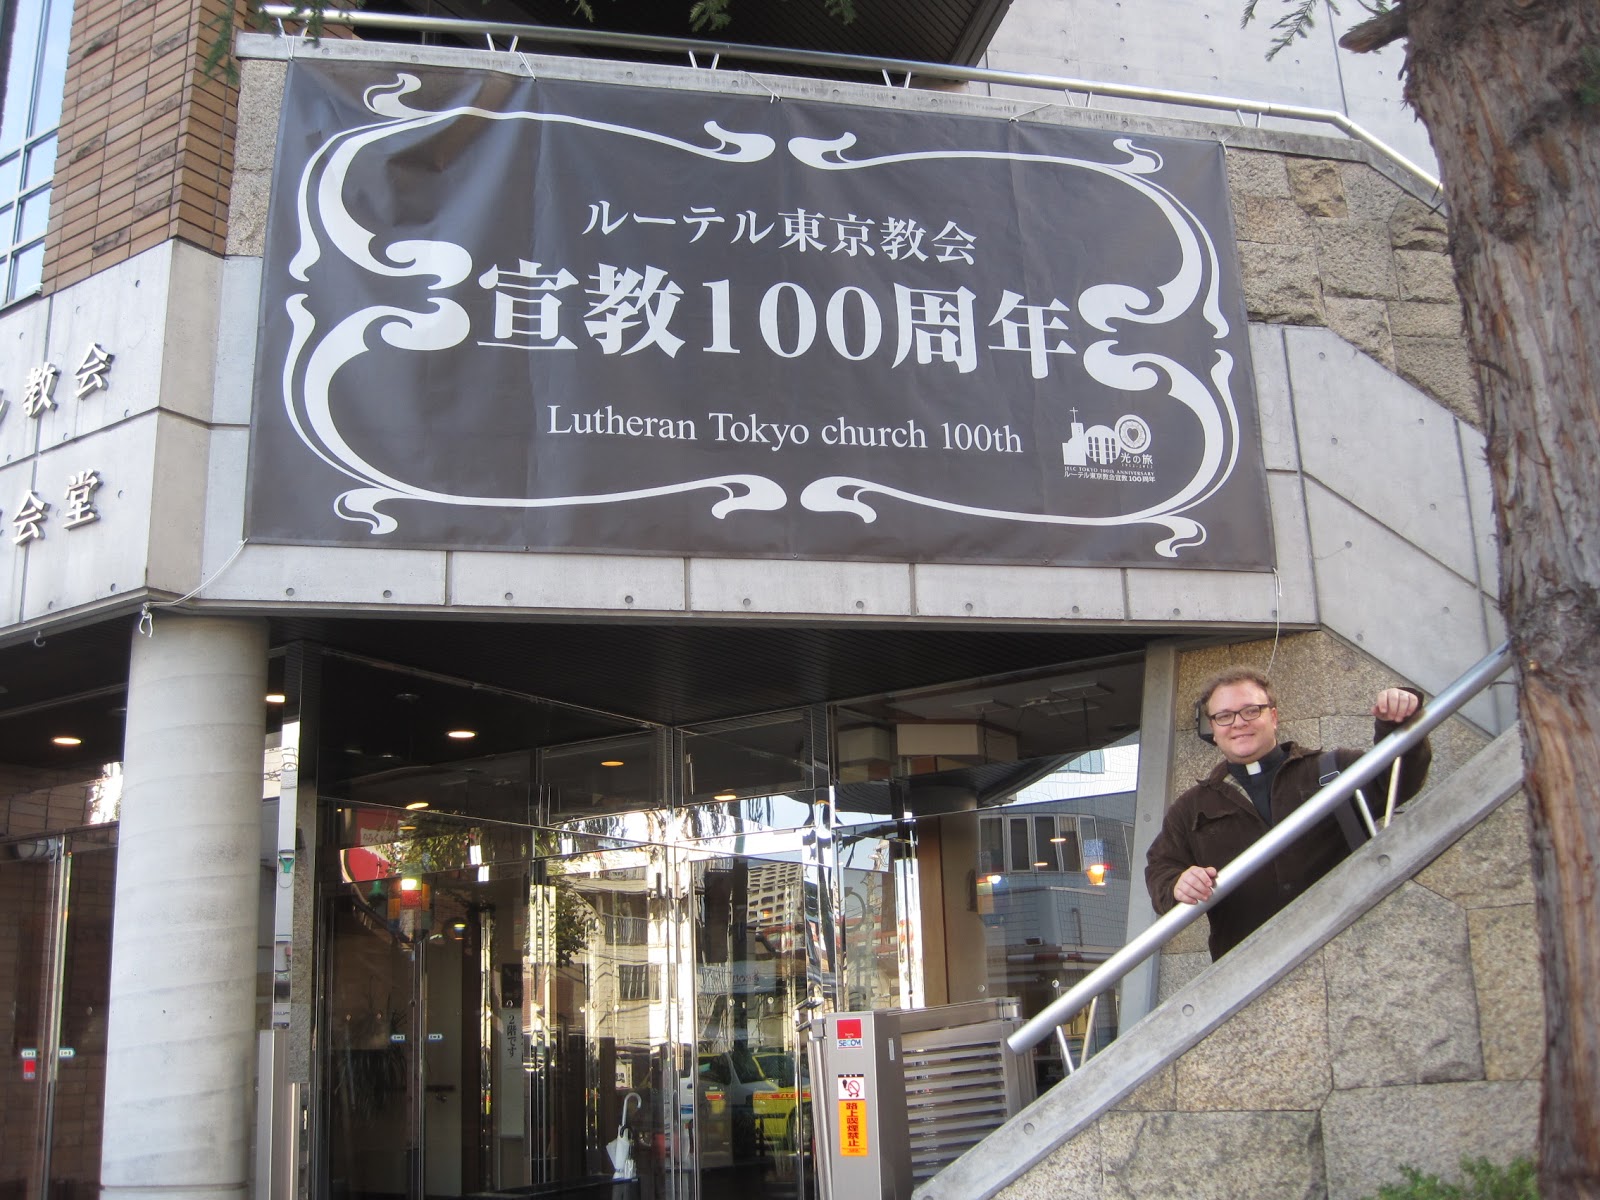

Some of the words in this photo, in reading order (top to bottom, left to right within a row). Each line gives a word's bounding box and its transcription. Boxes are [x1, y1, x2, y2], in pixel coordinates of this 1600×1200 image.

[583, 201, 977, 264] ルーテル東京教会
[477, 258, 1077, 379] 宣教100周年
[0, 342, 114, 427] 教会
[547, 405, 696, 440] Lutheran
[708, 412, 810, 452] Tokyo
[821, 416, 927, 448] church
[941, 422, 1024, 453] 100th
[1120, 452, 1153, 465] 光の旅
[838, 1039, 861, 1047] SECOM
[846, 1102, 860, 1147] 路上喫煙禁止
